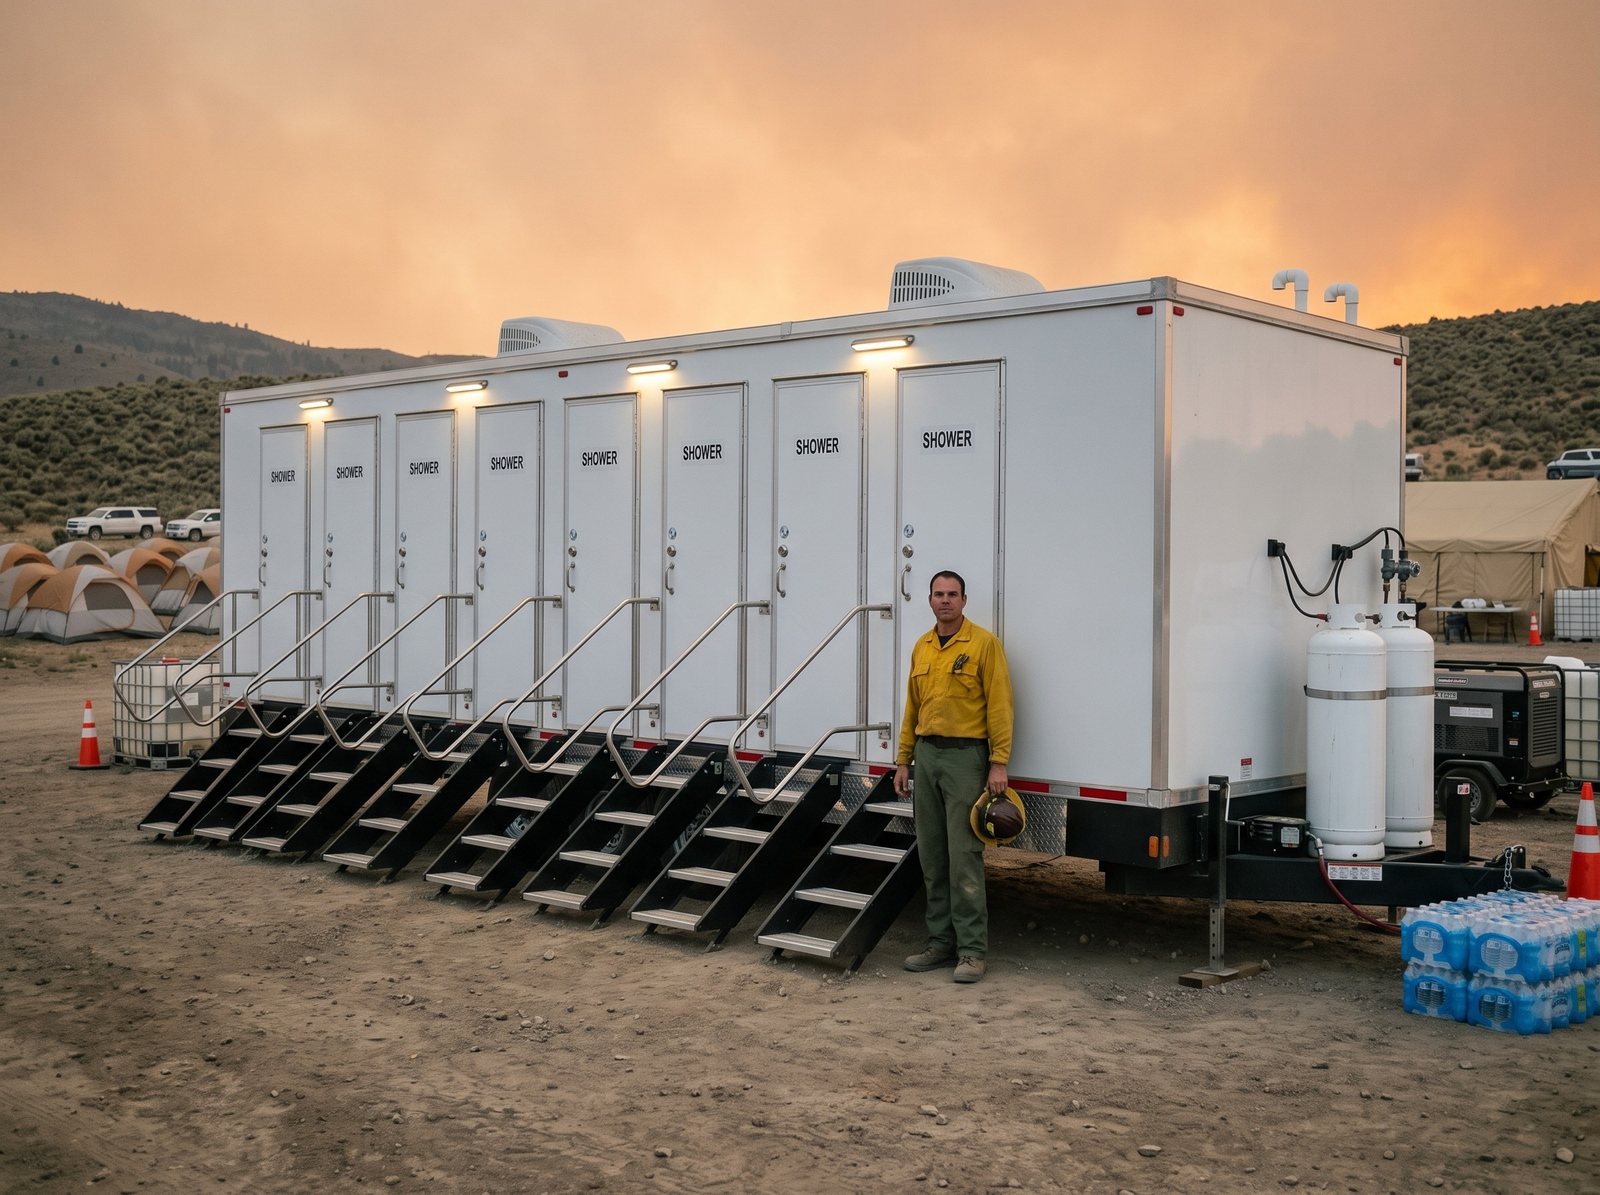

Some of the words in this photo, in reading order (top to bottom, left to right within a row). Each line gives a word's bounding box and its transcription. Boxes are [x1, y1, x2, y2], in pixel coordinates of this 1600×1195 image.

[796, 438, 839, 455] SHOWER
[923, 430, 972, 449] SHOWER
[582, 451, 617, 467] SHOWER
[683, 444, 722, 460] SHOWER
[410, 461, 439, 475] SHOWER
[491, 456, 523, 470] SHOWER
[271, 470, 296, 483] SHOWER
[337, 466, 363, 479] SHOWER
